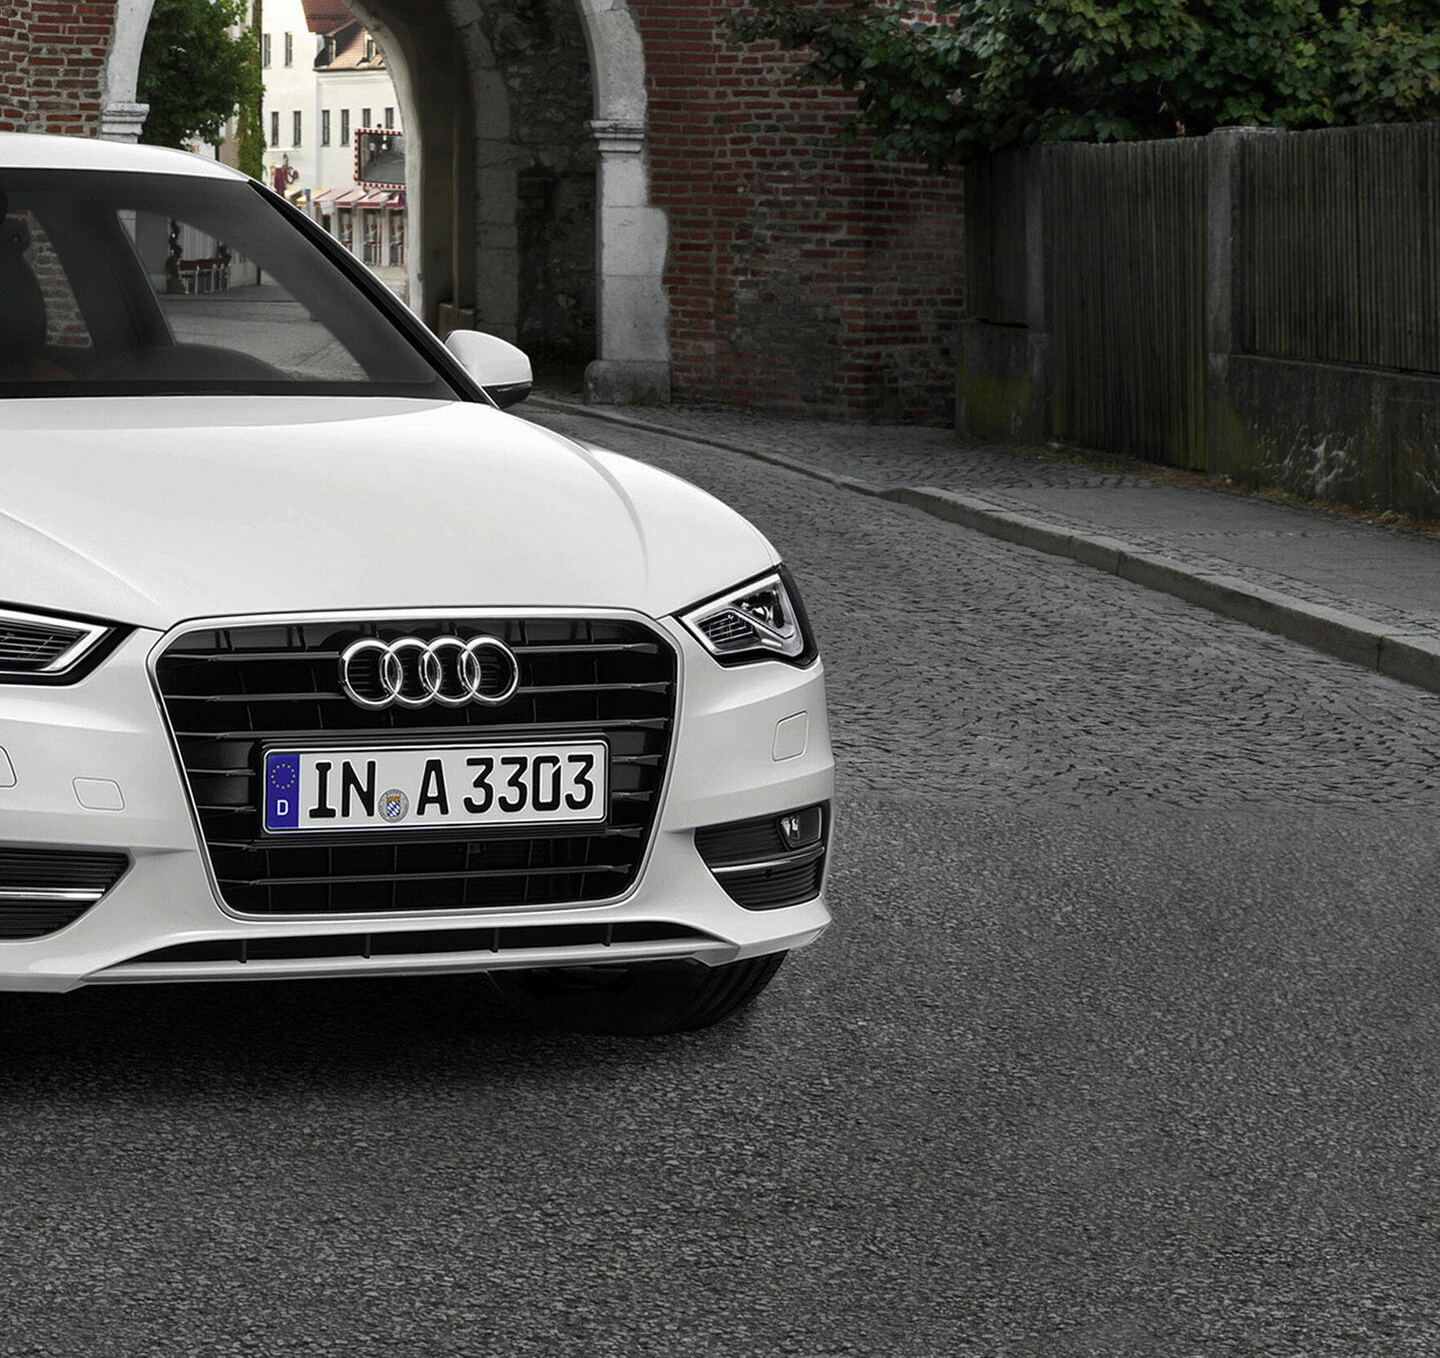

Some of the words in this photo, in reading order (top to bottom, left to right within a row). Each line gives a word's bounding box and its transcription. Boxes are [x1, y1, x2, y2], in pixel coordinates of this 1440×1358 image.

[308, 760, 377, 819] IN
[416, 758, 449, 816] A
[463, 753, 594, 813] 3303
[276, 799, 290, 816] D
